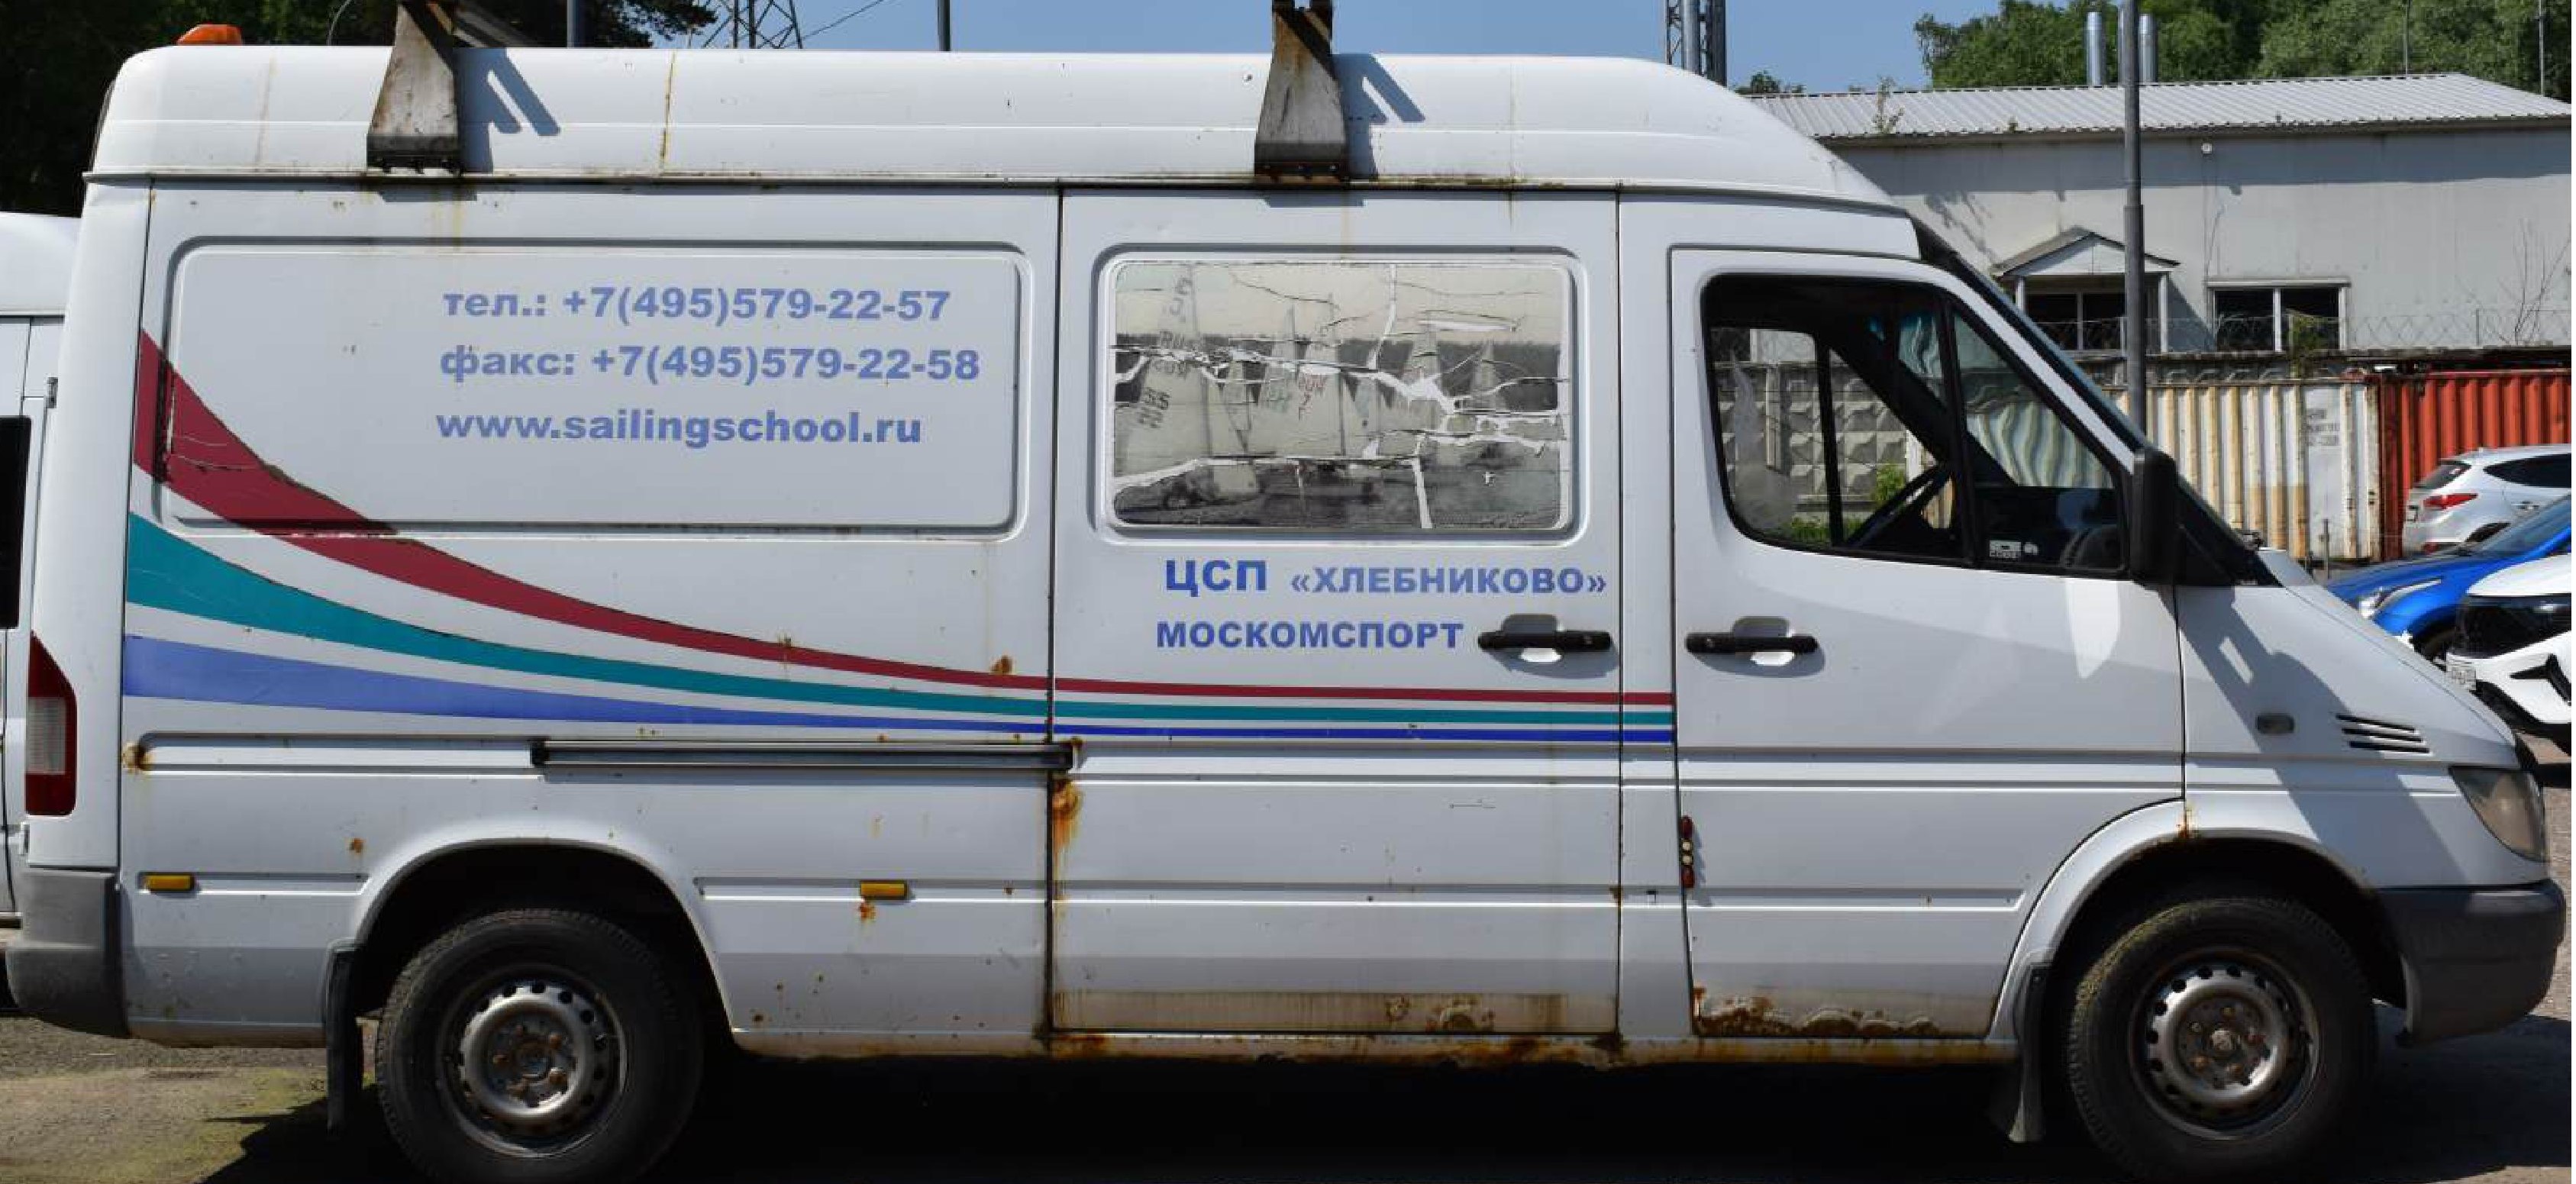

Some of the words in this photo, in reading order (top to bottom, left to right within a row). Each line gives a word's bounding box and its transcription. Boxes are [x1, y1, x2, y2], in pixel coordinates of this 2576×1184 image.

[444, 292, 545, 317] тел.:
[564, 286, 951, 326] +7(495)579-22-57
[441, 345, 575, 383] факс:
[592, 346, 980, 385] +7(495)579-22-58
[437, 409, 922, 449] www.sailingschool.ru
[1165, 560, 1267, 598] ЦСП
[1291, 567, 1607, 595] «ХЛЕБНИКОВО»
[1157, 621, 1464, 649] МОСКОМСПОРТ
